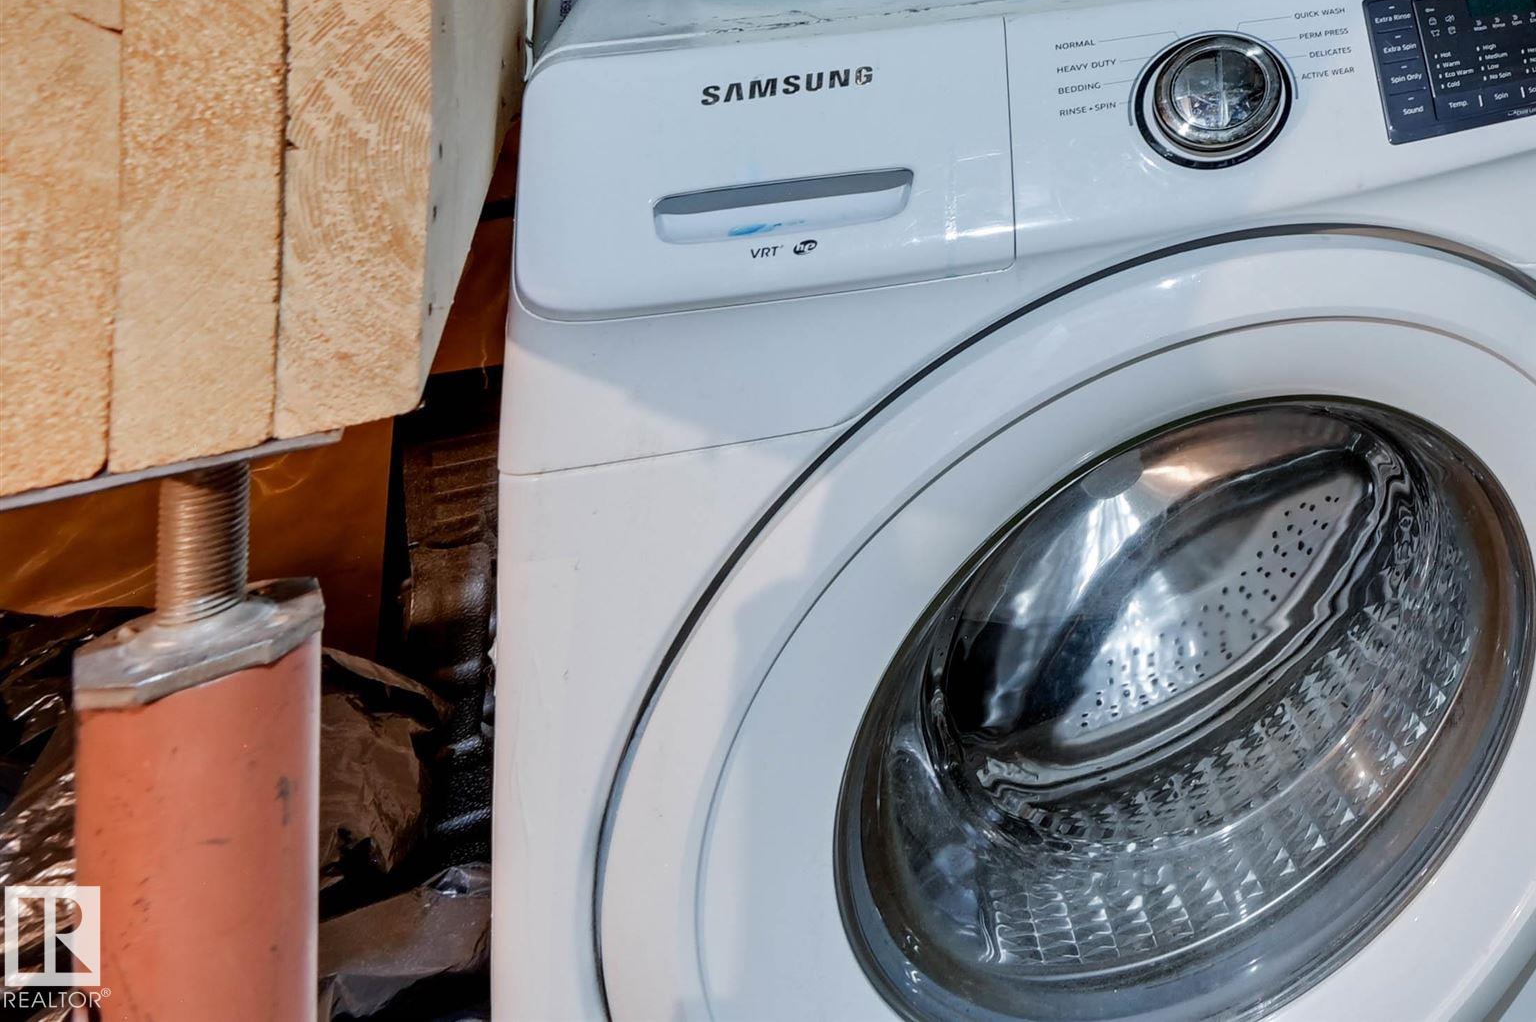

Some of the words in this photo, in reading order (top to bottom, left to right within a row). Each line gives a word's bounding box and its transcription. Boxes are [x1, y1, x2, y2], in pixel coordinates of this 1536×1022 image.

[1294, 11, 1320, 20] QUICK
[1322, 7, 1346, 16] WASH
[1374, 14, 1393, 25] Extra
[1393, 12, 1412, 21] Rinse
[1299, 31, 1322, 40] PERM
[1324, 27, 1349, 37] PRESS
[1054, 39, 1096, 51] NORMAL
[1383, 44, 1402, 55] Extra
[1402, 42, 1417, 52] Spin
[1482, 43, 1497, 52] High
[1309, 46, 1353, 59] DELICATES
[1440, 51, 1452, 59] Hot
[1485, 50, 1509, 61] Medium
[1056, 63, 1089, 74] HEAVY
[1092, 59, 1117, 70] DUTY
[1442, 60, 1462, 69] Warm
[1487, 62, 1500, 71] Low
[1301, 70, 1329, 80] ACTIVE
[1331, 66, 1355, 76] WEAR
[1390, 74, 1405, 85] Spin
[1406, 72, 1423, 83] Only
[1444, 71, 1457, 79] Eco
[1457, 68, 1475, 77] Warm
[1499, 71, 1513, 81] Spin
[700, 65, 875, 107] SAMSUNG
[1058, 82, 1102, 95] BEDDING
[1447, 81, 1461, 89] Cold
[1494, 91, 1510, 102] Spin
[1059, 105, 1088, 117] RINSE
[1094, 101, 1117, 112] SPIN
[1403, 105, 1425, 116] Sound
[750, 245, 780, 260] VRT
